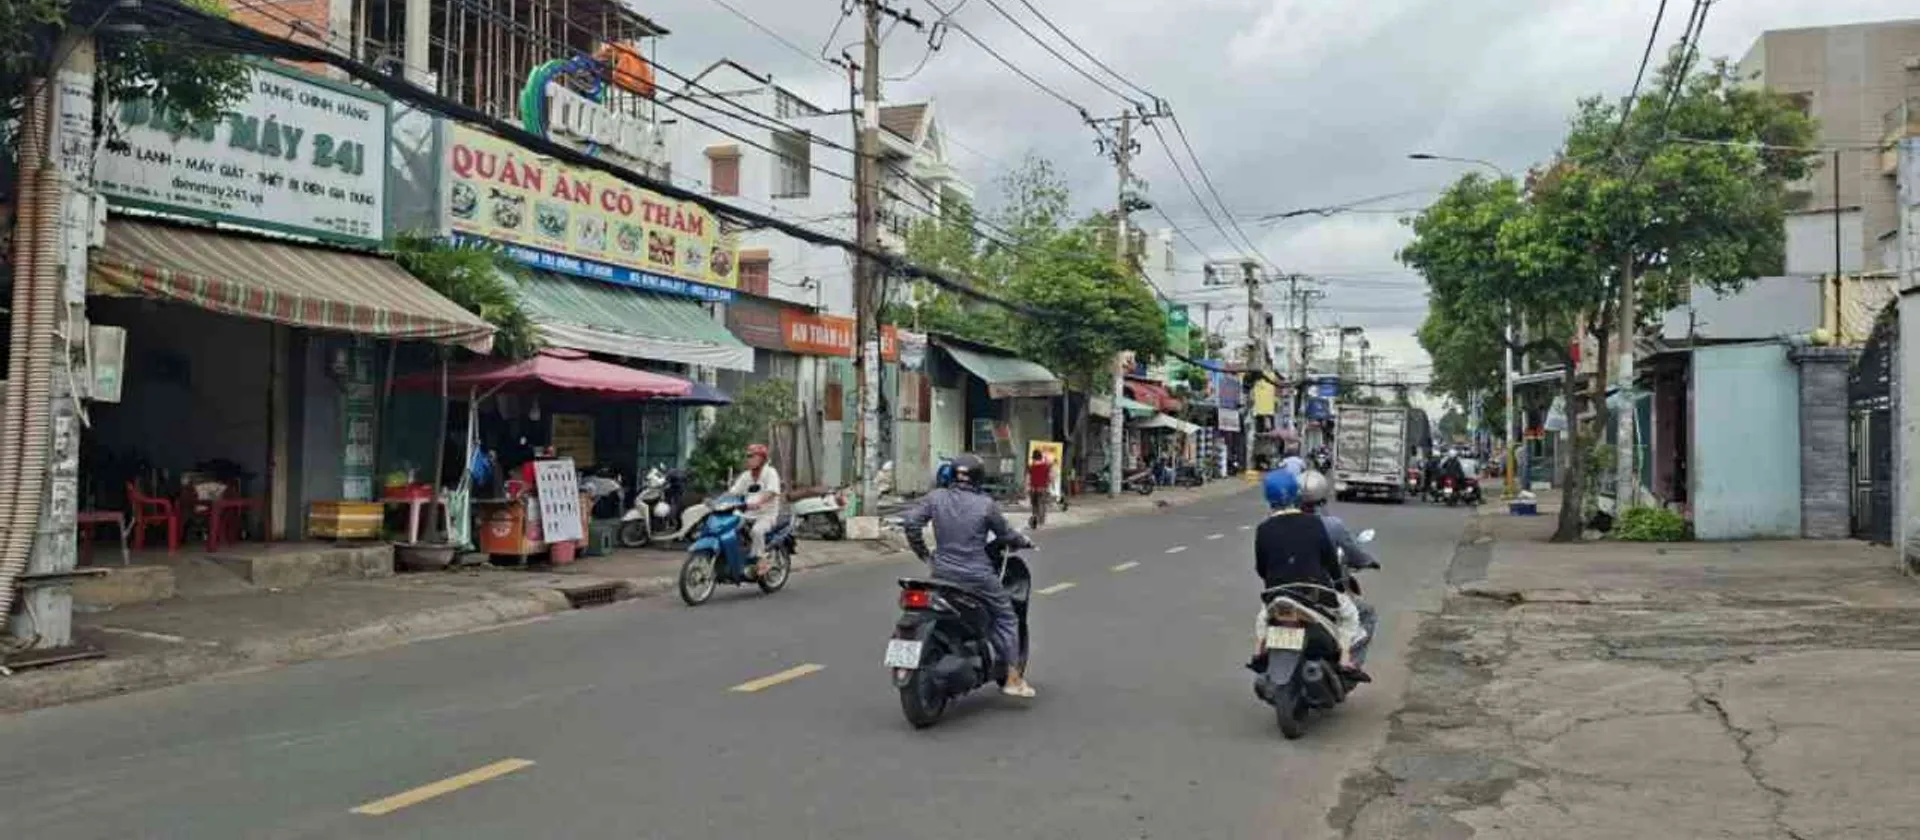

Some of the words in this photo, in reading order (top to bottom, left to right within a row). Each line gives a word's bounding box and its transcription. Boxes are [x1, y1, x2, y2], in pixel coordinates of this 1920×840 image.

[226, 111, 304, 160] MÁY
[185, 157, 215, 173] MÁY
[453, 144, 542, 193] QUÁN
[601, 187, 632, 216] CÔ
